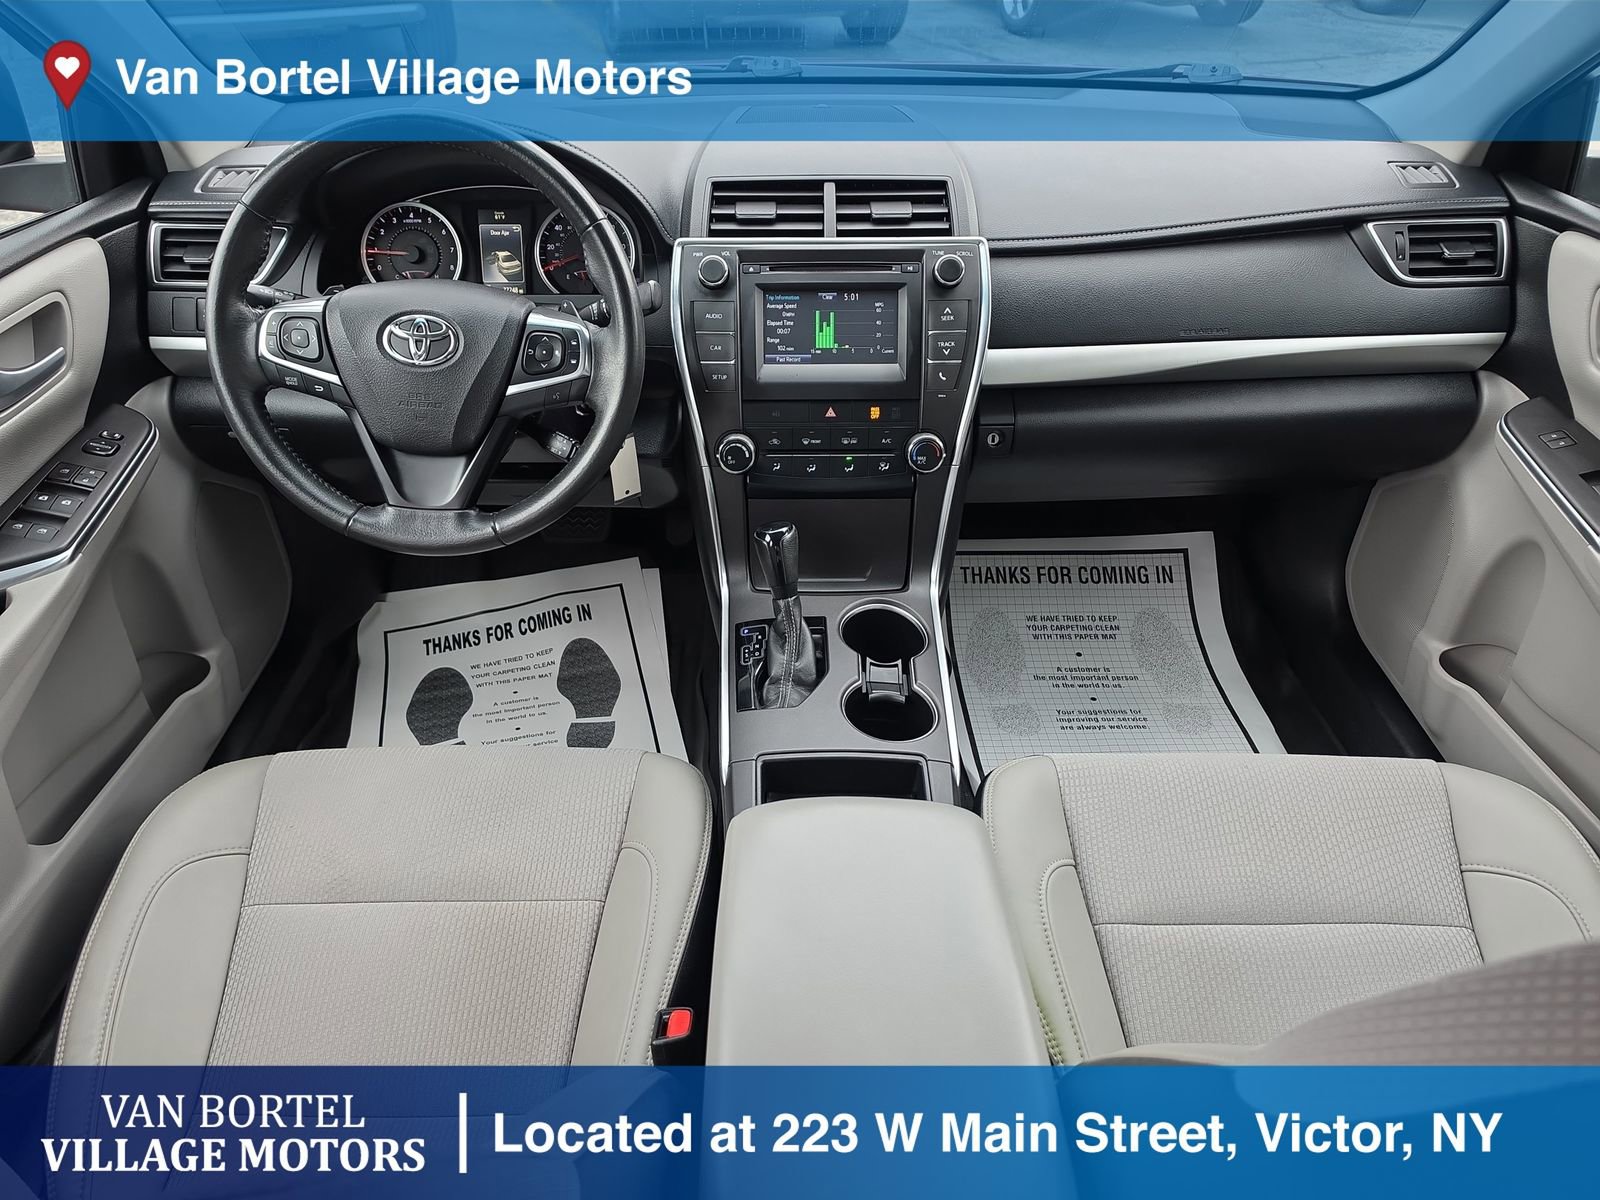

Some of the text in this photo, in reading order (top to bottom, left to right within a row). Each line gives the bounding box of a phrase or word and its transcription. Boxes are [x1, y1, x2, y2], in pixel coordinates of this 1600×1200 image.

[844, 293, 859, 301] 5:01
[960, 565, 1174, 585] THANKS FOR COMING IN
[422, 603, 593, 656] THANKS FOR COMING IN
[483, 660, 502, 668] HAVE
[503, 655, 523, 664] TRIED
[536, 647, 554, 657] KEEP
[471, 660, 556, 680] YOUR CARPETING CLEAN
[1070, 674, 1109, 682] important
[500, 697, 531, 706] customer
[504, 704, 536, 713] important
[500, 732, 544, 743] suggestions
[533, 739, 559, 747] service
